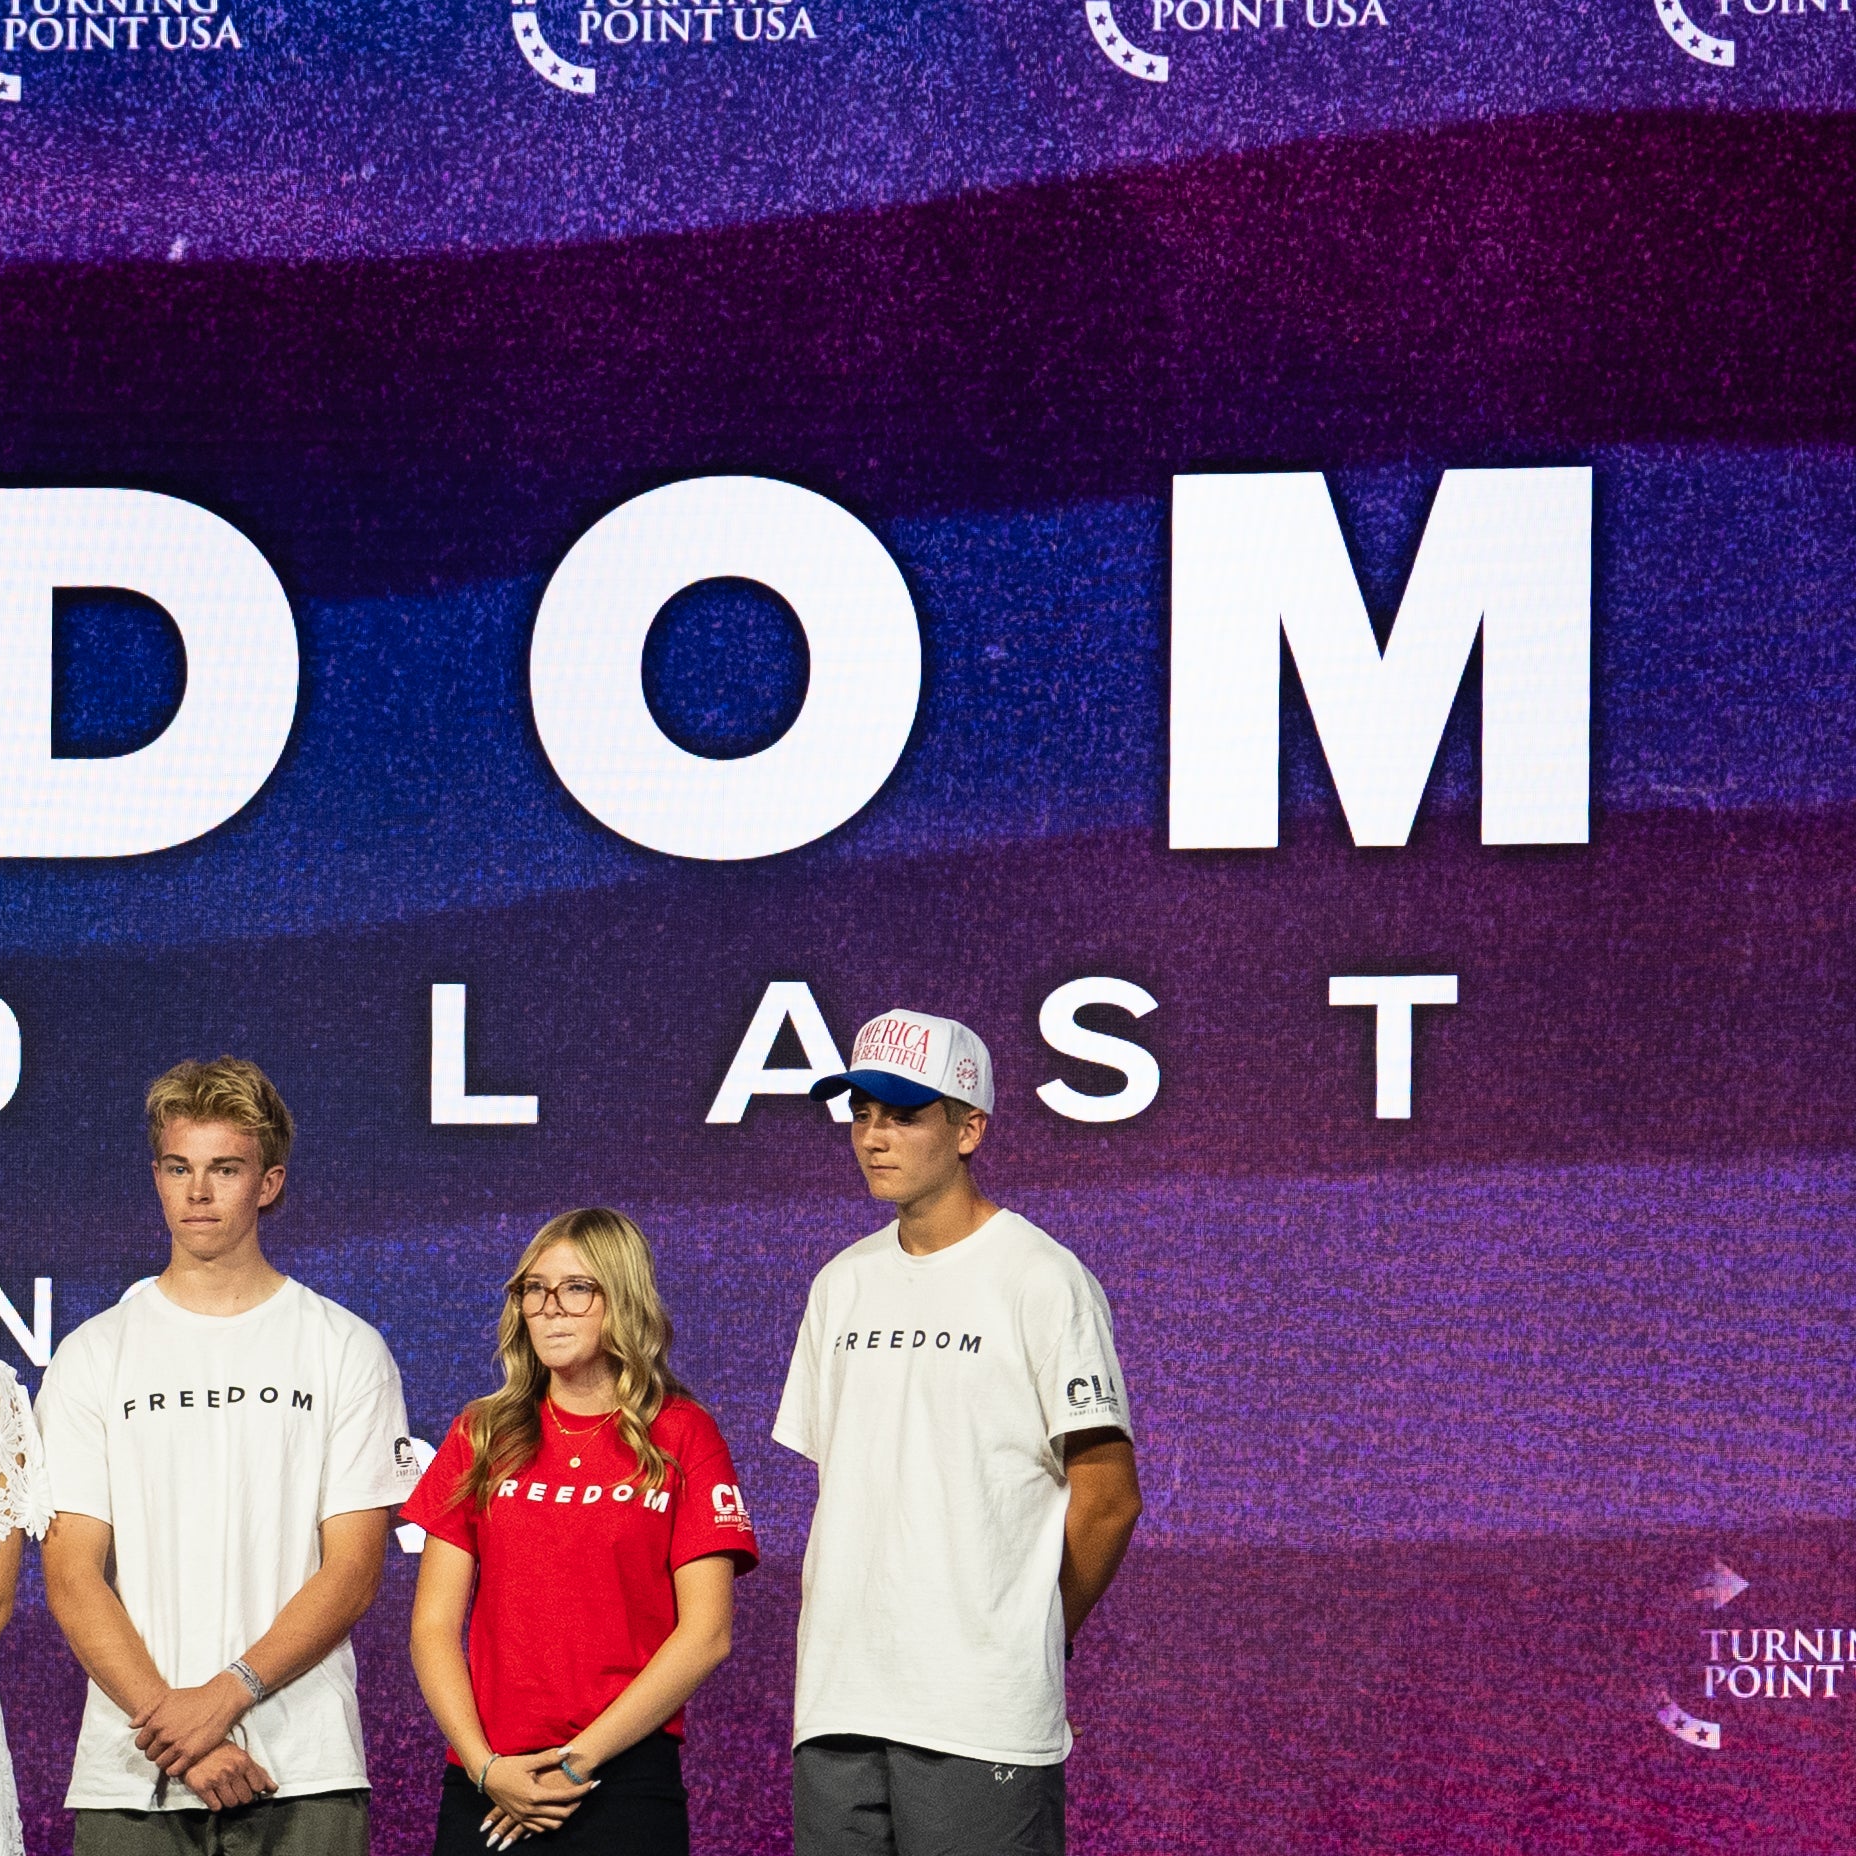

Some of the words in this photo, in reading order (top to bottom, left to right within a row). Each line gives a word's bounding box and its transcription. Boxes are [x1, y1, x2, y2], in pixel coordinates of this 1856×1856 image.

[578, 8, 723, 43] POINT
[734, 7, 817, 41] USA
[1152, 0, 1289, 31] POINT
[1306, 0, 1388, 28] USA
[4, 17, 148, 50] POINT
[158, 16, 242, 50] USA
[432, 976, 1457, 1123] LAST
[861, 1044, 928, 1074] BEAUTIFUL
[124, 1387, 313, 1420] FREEDOM
[498, 1479, 670, 1513] REEDOM
[1699, 1628, 1856, 1662] TURNI
[1704, 1664, 1845, 1699] POINT
